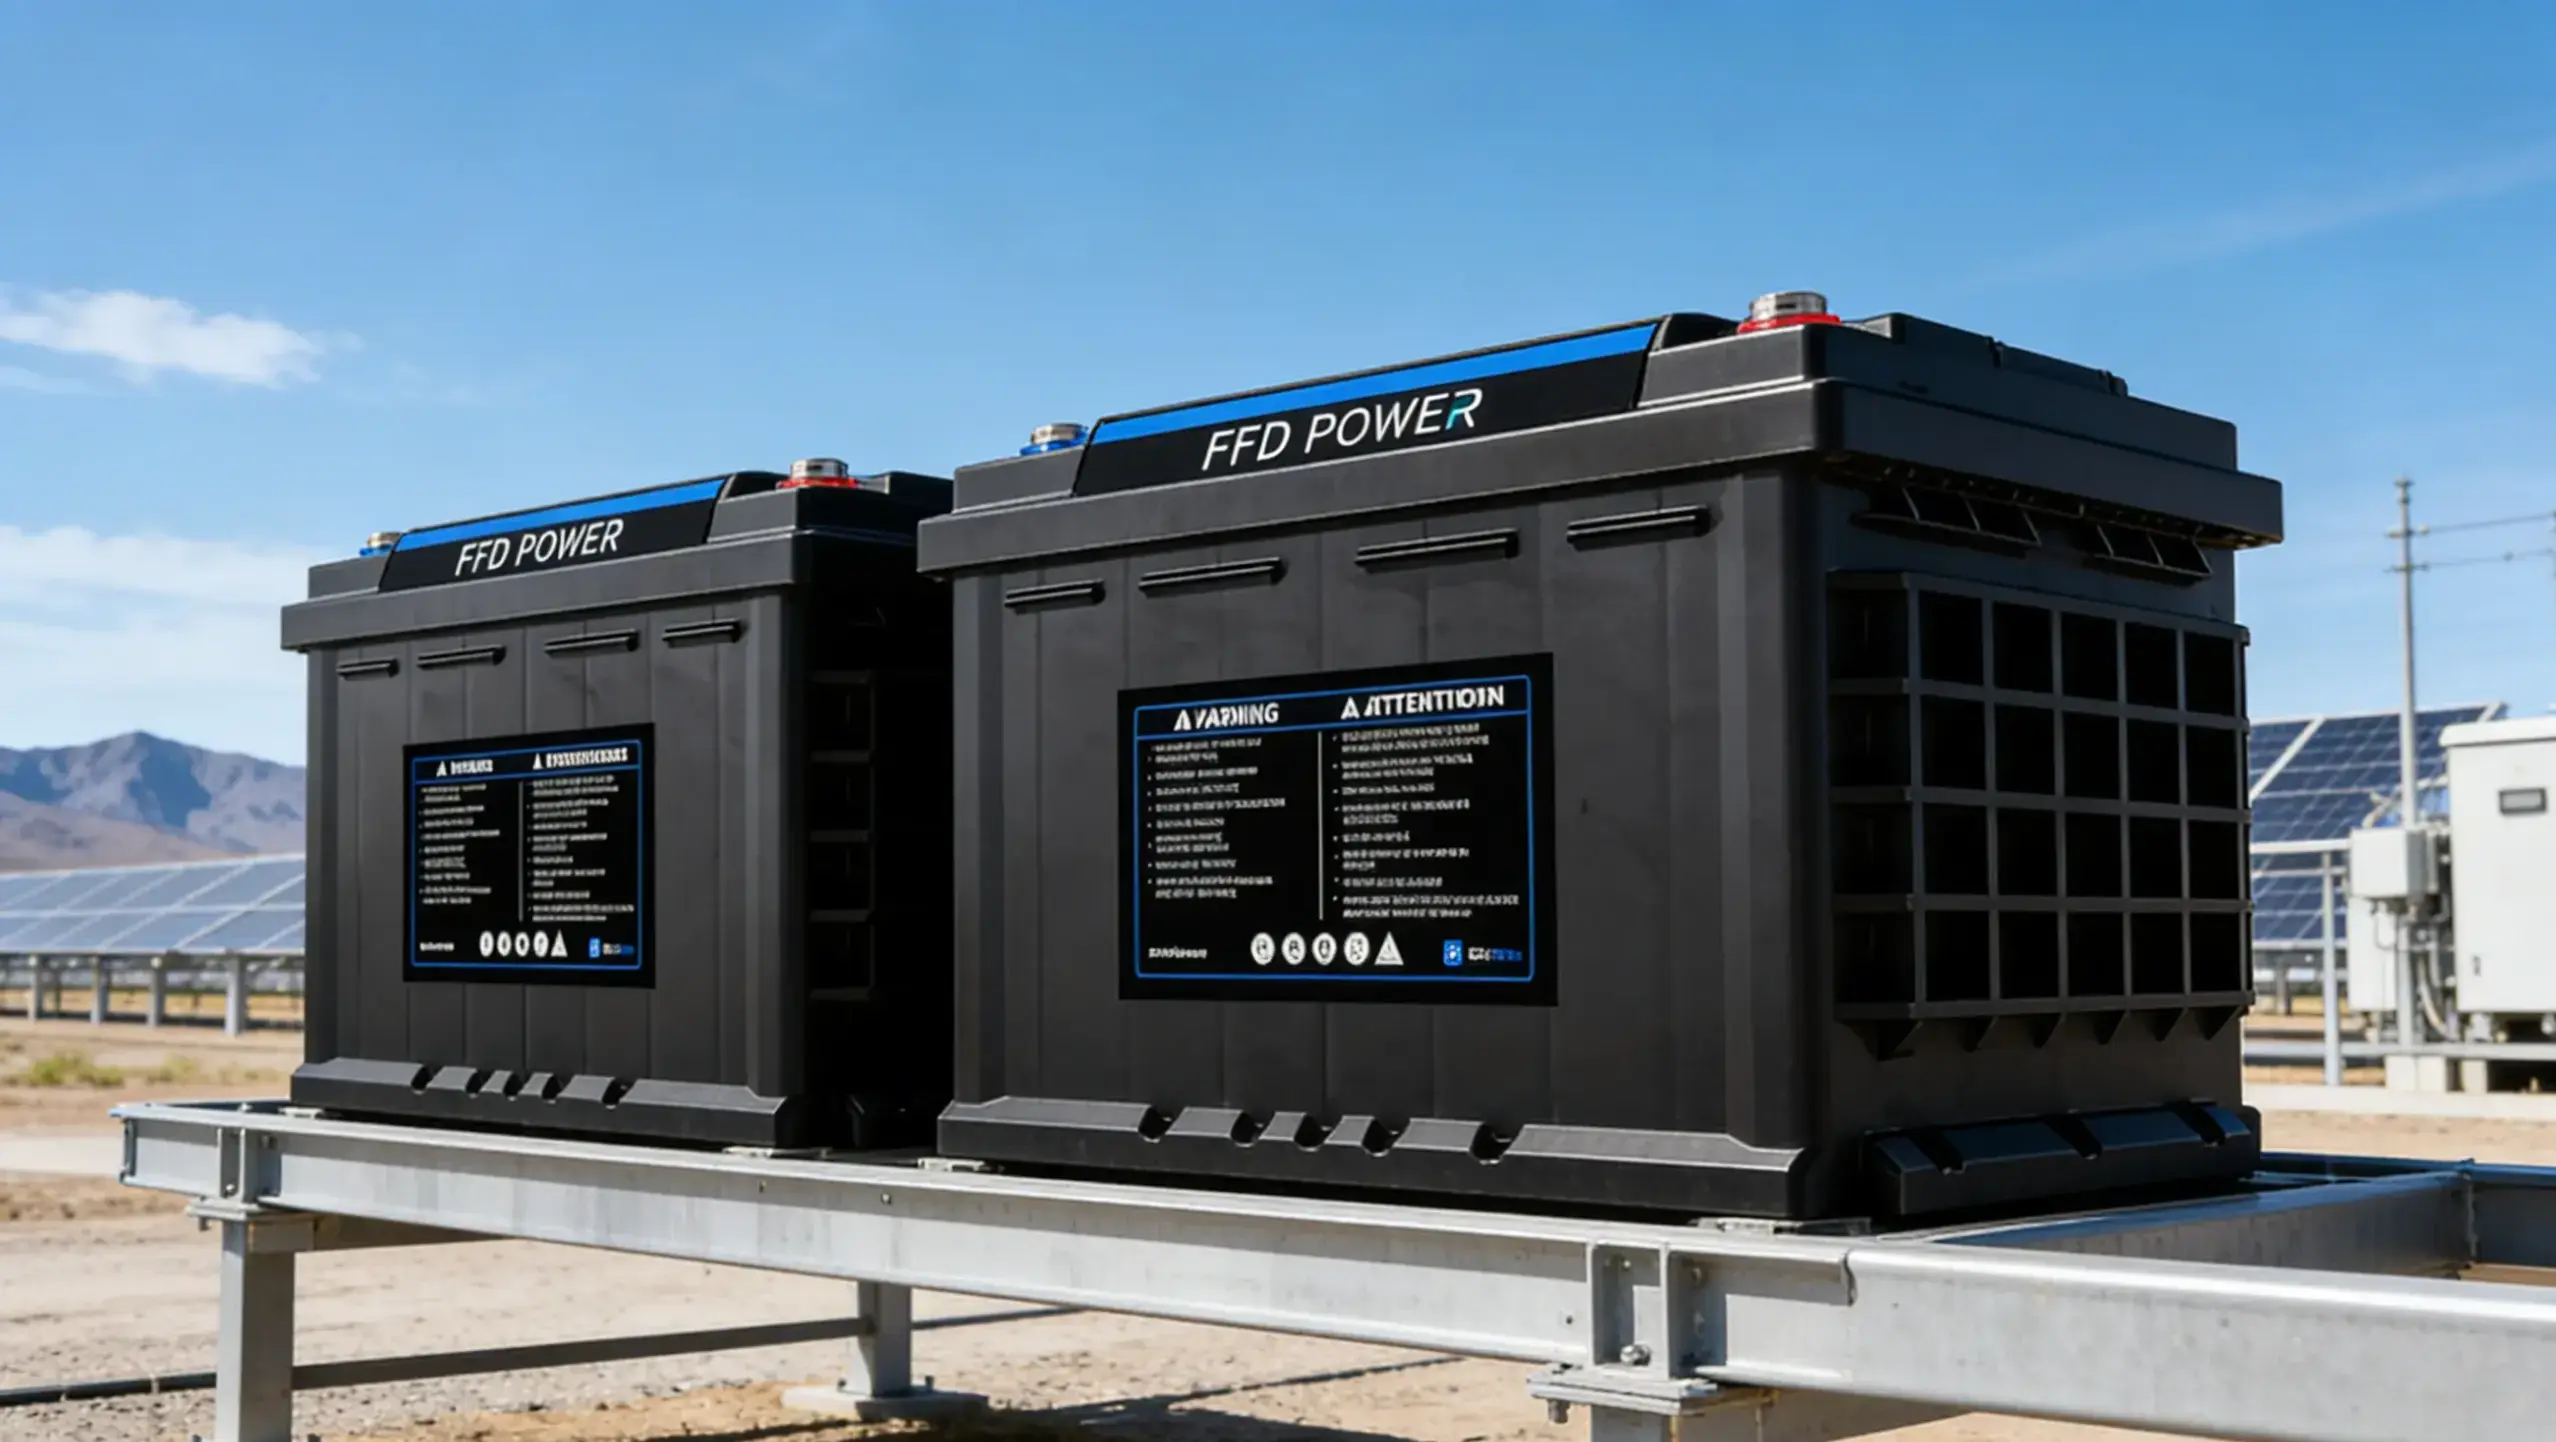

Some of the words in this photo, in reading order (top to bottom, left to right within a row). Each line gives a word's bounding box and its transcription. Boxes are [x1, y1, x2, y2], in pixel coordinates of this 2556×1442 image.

[1202, 420, 1291, 471] FFD
[1304, 388, 1483, 454] POWER
[455, 538, 511, 577] FFD
[515, 518, 624, 567] POWER
